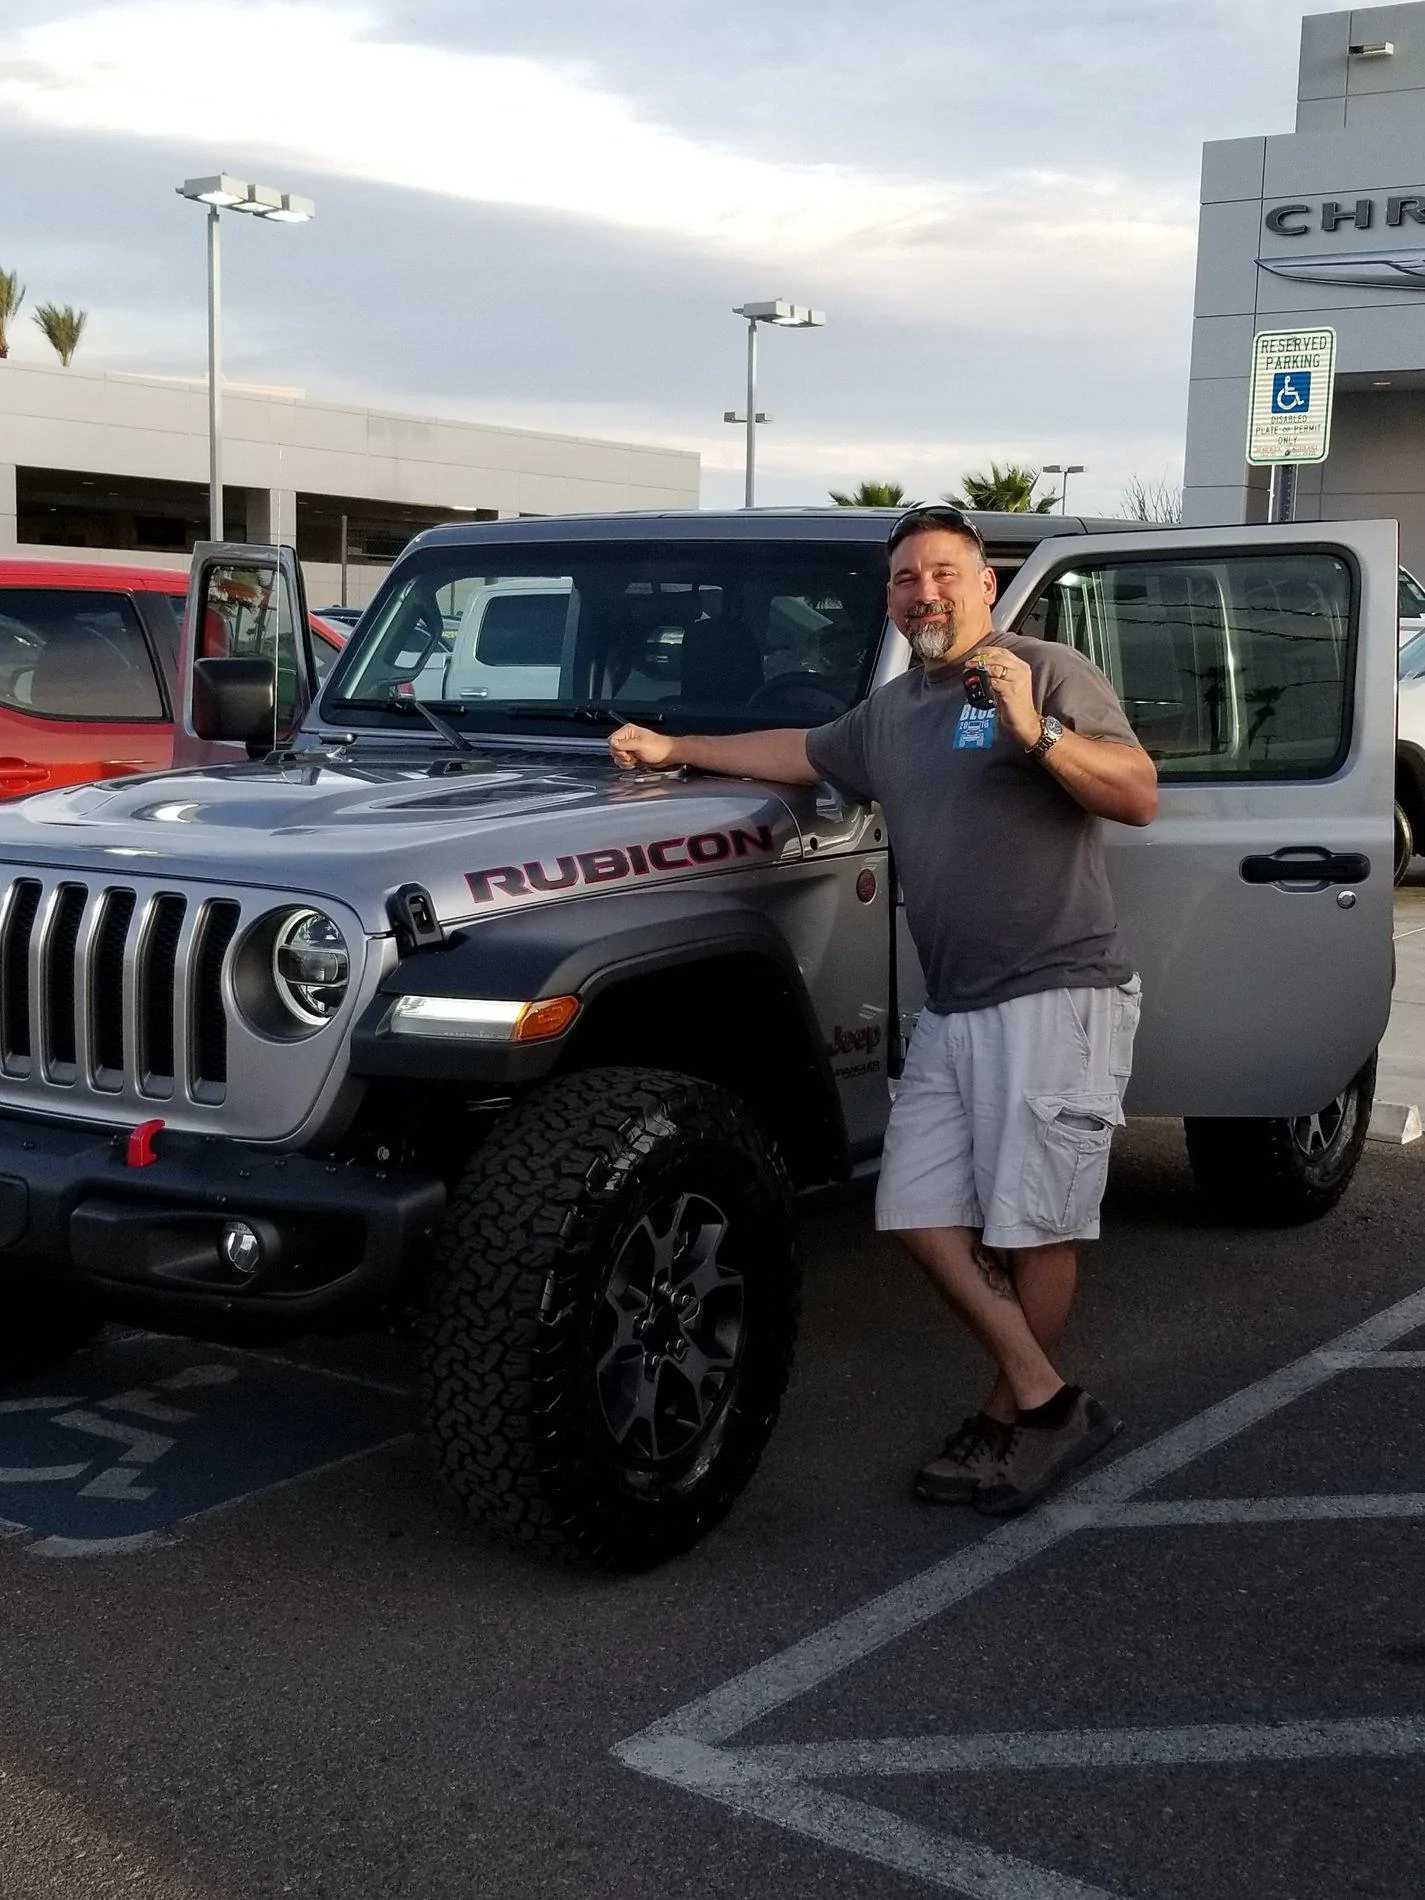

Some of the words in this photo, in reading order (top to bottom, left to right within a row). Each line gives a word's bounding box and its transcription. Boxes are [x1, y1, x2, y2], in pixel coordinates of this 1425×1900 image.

[1261, 335, 1328, 354] RESERVED
[1265, 353, 1321, 371] PARKING
[1271, 414, 1308, 425] DISABLED
[1255, 425, 1279, 436] PLATE
[1293, 424, 1321, 434] PERMIT
[1277, 435, 1298, 445] ONLY
[959, 703, 996, 721] BLUE
[464, 825, 774, 904] RUBICON
[827, 1025, 881, 1057] Jeep
